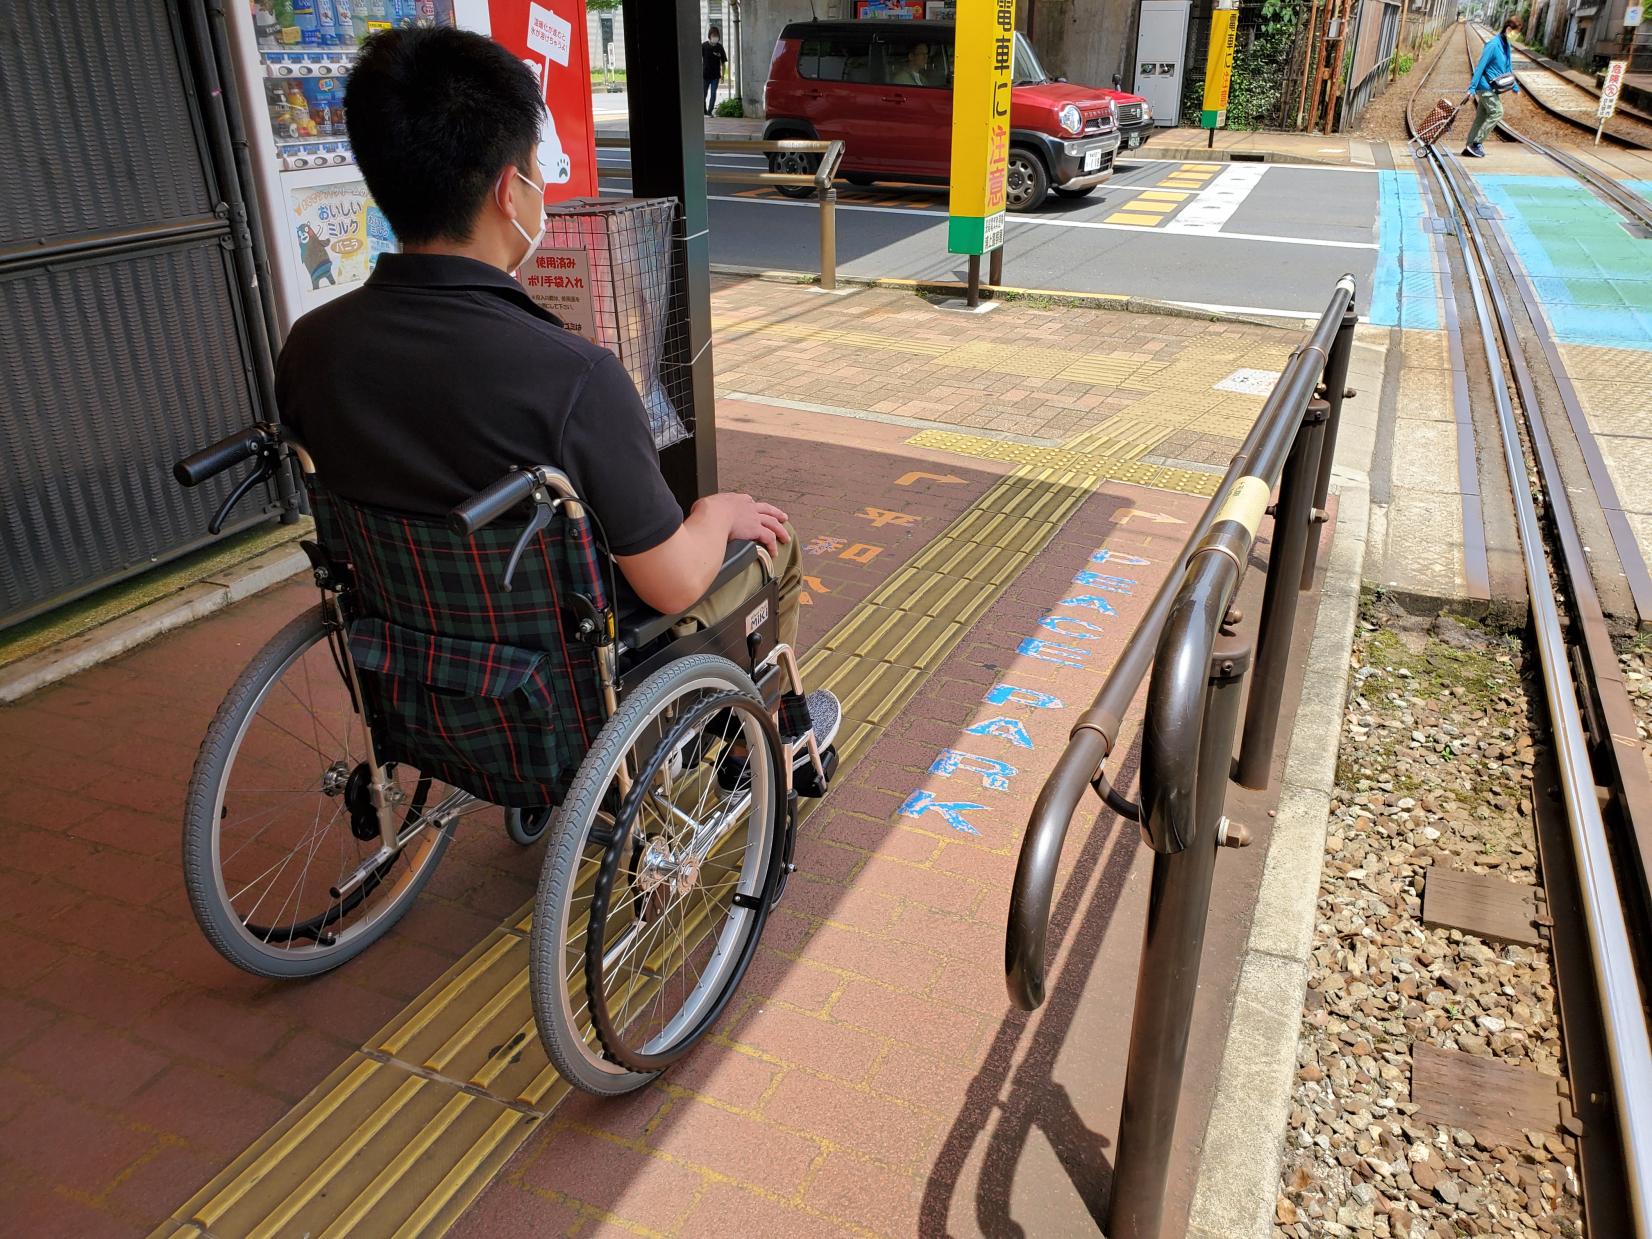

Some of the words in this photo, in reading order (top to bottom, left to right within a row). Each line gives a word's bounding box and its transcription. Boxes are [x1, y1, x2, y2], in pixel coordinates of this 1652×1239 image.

[319, 201, 362, 220] おいしい
[328, 219, 359, 236] ミルク
[336, 239, 359, 251] バニラ
[536, 256, 577, 270] 使用済み
[528, 275, 584, 289] ポリ手袋入れ
[751, 607, 768, 627] MIKI
[1016, 548, 1151, 669] PEACE
[898, 683, 1064, 837] PARK
